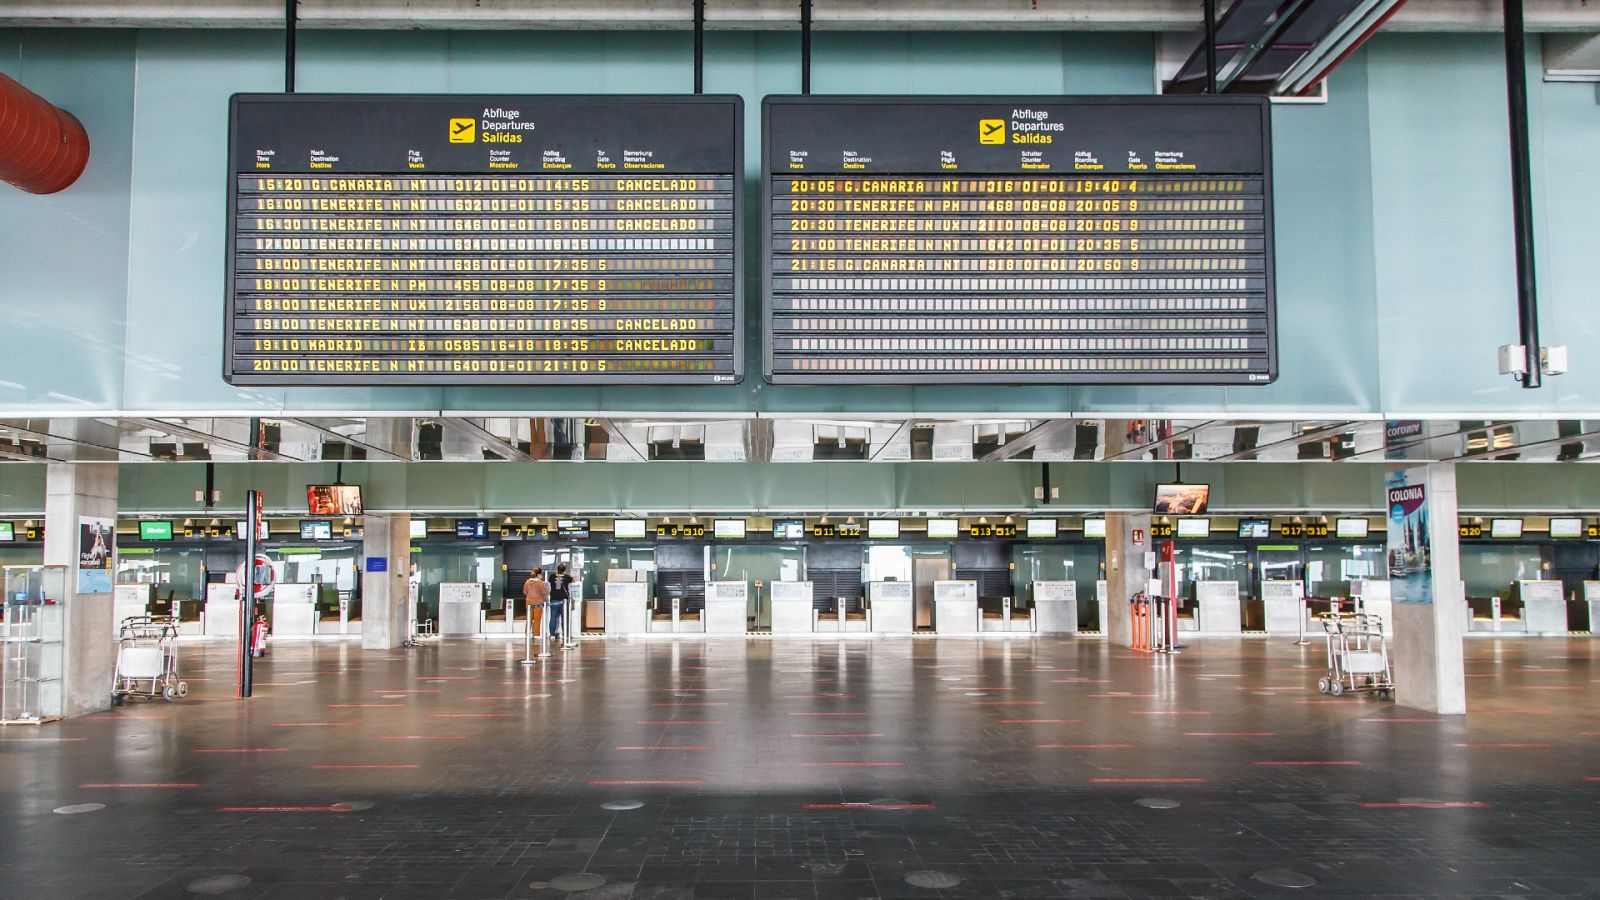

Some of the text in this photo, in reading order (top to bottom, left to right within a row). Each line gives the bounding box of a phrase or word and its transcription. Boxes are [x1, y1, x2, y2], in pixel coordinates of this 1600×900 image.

[482, 108, 520, 119] Abfluge
[1012, 109, 1048, 121] Abfluge
[482, 120, 535, 132] Departures
[1012, 121, 1064, 132] Departures
[482, 132, 523, 143] Salidas
[1012, 133, 1053, 144] Salidas
[311, 179, 391, 191] G.CANARIA
[410, 179, 427, 191] NT
[455, 179, 481, 191] 312
[491, 179, 535, 191] 01-01
[545, 179, 589, 191] 14:55
[617, 179, 697, 191] CANCELADO
[791, 180, 1137, 192] 20:05 G.CANARIA NT 316 01-01 19:40 4
[257, 199, 697, 211] 16:00 TENERIFE N NT 632 01-01 15:35 CANCELADO
[791, 200, 1138, 212] 20:30 TENERIFE N PM 468 08-08 20:05 9
[257, 219, 301, 230] 16:30
[311, 219, 382, 230] TENERIFE
[392, 219, 400, 230] N
[410, 219, 427, 230] NT
[491, 219, 535, 230] 01-01
[545, 219, 589, 230] 16:05
[617, 219, 697, 231] CANCELADO
[791, 220, 1138, 231] 20:30 TENERIFE N UX 2110 08-08 20:05 9
[310, 239, 382, 250] TENERIFE
[391, 239, 400, 250] N
[409, 239, 427, 250] NT
[490, 239, 535, 250] 01-01
[792, 240, 1138, 251] 21:00 TENERIFE N NT 642 01-01 20:35 5
[256, 259, 607, 270] 18:00 TENERIFE N NT 636 01-01 17:35 5
[792, 259, 835, 271] 21:15
[845, 259, 925, 271] G.CANARIA
[943, 259, 960, 271] NT
[988, 259, 1014, 271] 318
[1024, 259, 1067, 271] 01-01
[1131, 260, 1139, 271] 9
[256, 279, 607, 291] 18:00 TENERIFE N PM 455 08-08 17:35 9
[255, 299, 607, 311] 18:00 TENERIFE N UX 2156 08-08 17:35 9
[255, 319, 697, 330] 19:00 TENERIFE N NT 638 01-01 18:35 CANCELADO
[255, 340, 697, 351] 19:10 MADRID IB 0585 16-18 18:35 CANCELADO
[254, 360, 606, 371] 20:00 TENERIFE N NT 640 01-01 21:10 5
[1390, 487, 1423, 502] COLONIA
[693, 527, 704, 536] 10
[823, 527, 834, 536] 11
[849, 527, 860, 536] 12
[980, 527, 991, 536] 13
[1005, 527, 1015, 536] 14
[1291, 527, 1301, 535] 17
[1316, 527, 1327, 535] 18
